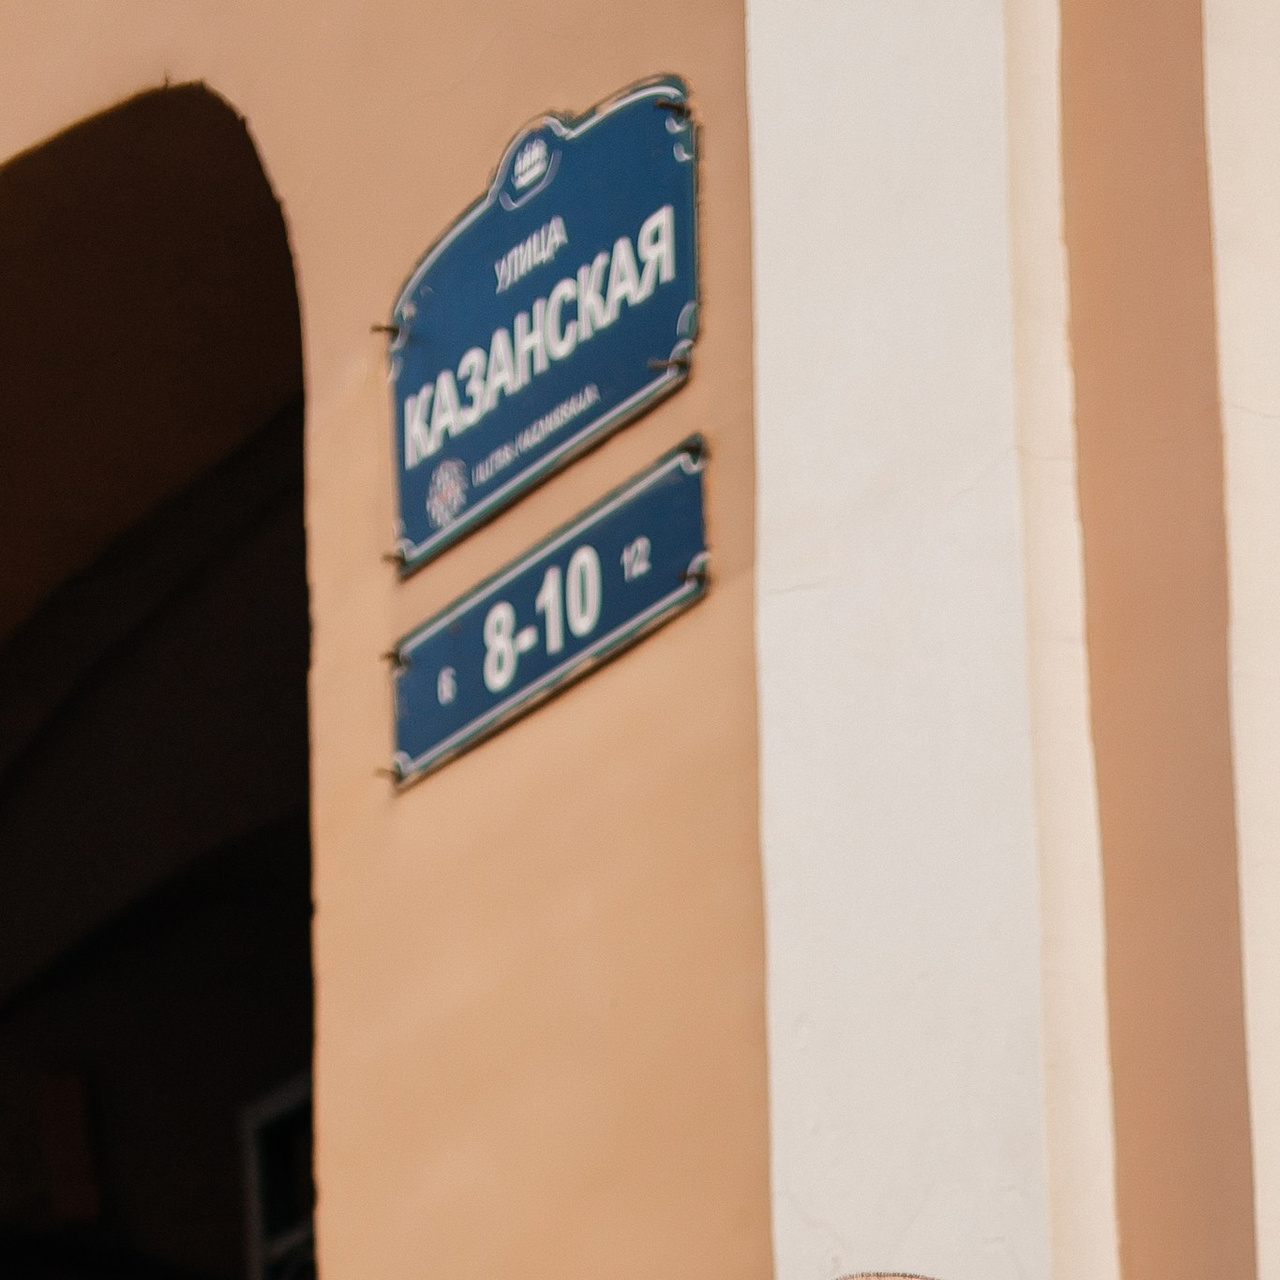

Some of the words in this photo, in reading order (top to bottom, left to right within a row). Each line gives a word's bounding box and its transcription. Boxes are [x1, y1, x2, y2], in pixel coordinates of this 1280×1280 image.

[494, 214, 568, 294] УЛИЦА
[404, 203, 676, 471] КАЗАНСКАЯ
[483, 545, 600, 693] 8-10
[619, 535, 651, 583] 12
